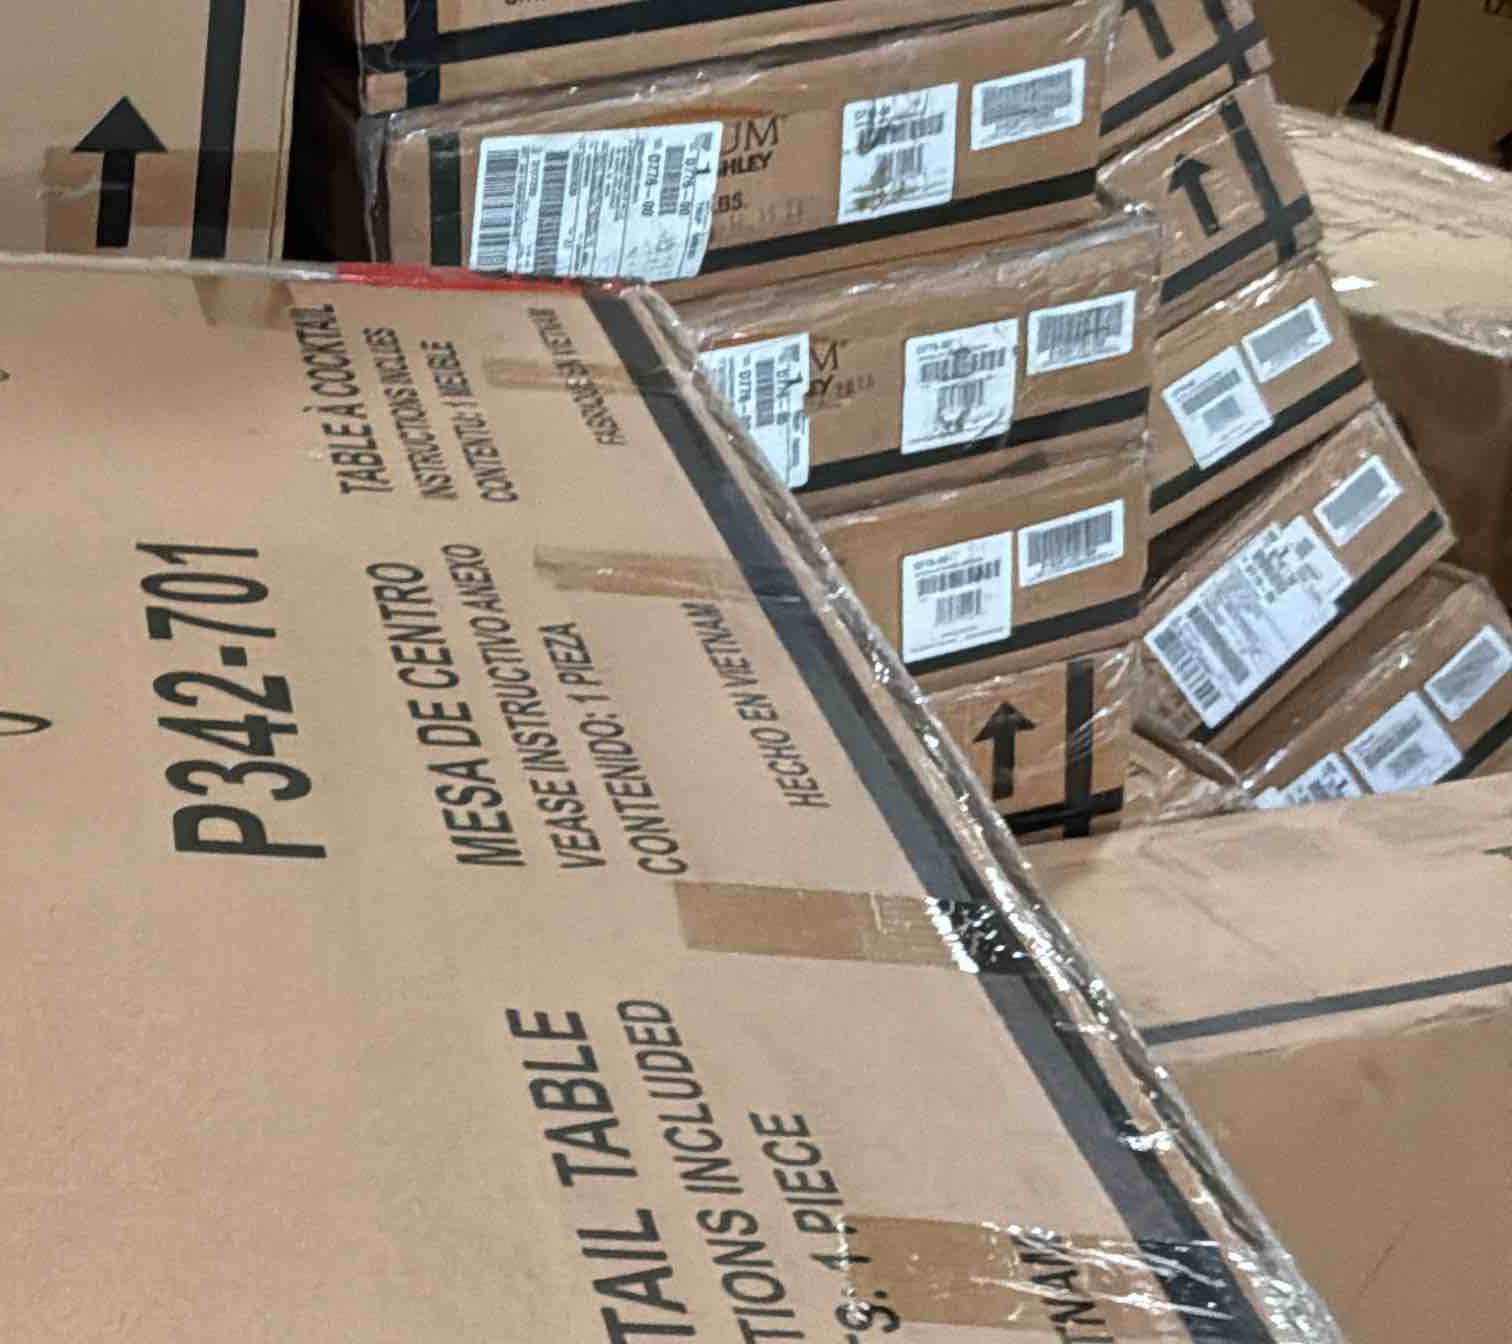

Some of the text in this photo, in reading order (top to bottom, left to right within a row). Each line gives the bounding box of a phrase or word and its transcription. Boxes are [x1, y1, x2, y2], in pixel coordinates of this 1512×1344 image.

[289, 303, 363, 399] COCKTAIL
[322, 422, 393, 496] TABLE
[134, 541, 327, 859] P342-701
[366, 560, 527, 868] MESA DE CENTRO
[441, 542, 607, 870] VEASE INSTRUCTIVO ANEXO
[538, 622, 594, 689] PIEZA
[681, 601, 831, 809] HECHO EN VIETNAM
[579, 709, 688, 876] CONTENIDO:
[505, 1007, 638, 1189] TABLE
[617, 999, 745, 1196] INCLUDED
[748, 1110, 861, 1240] PIECE
